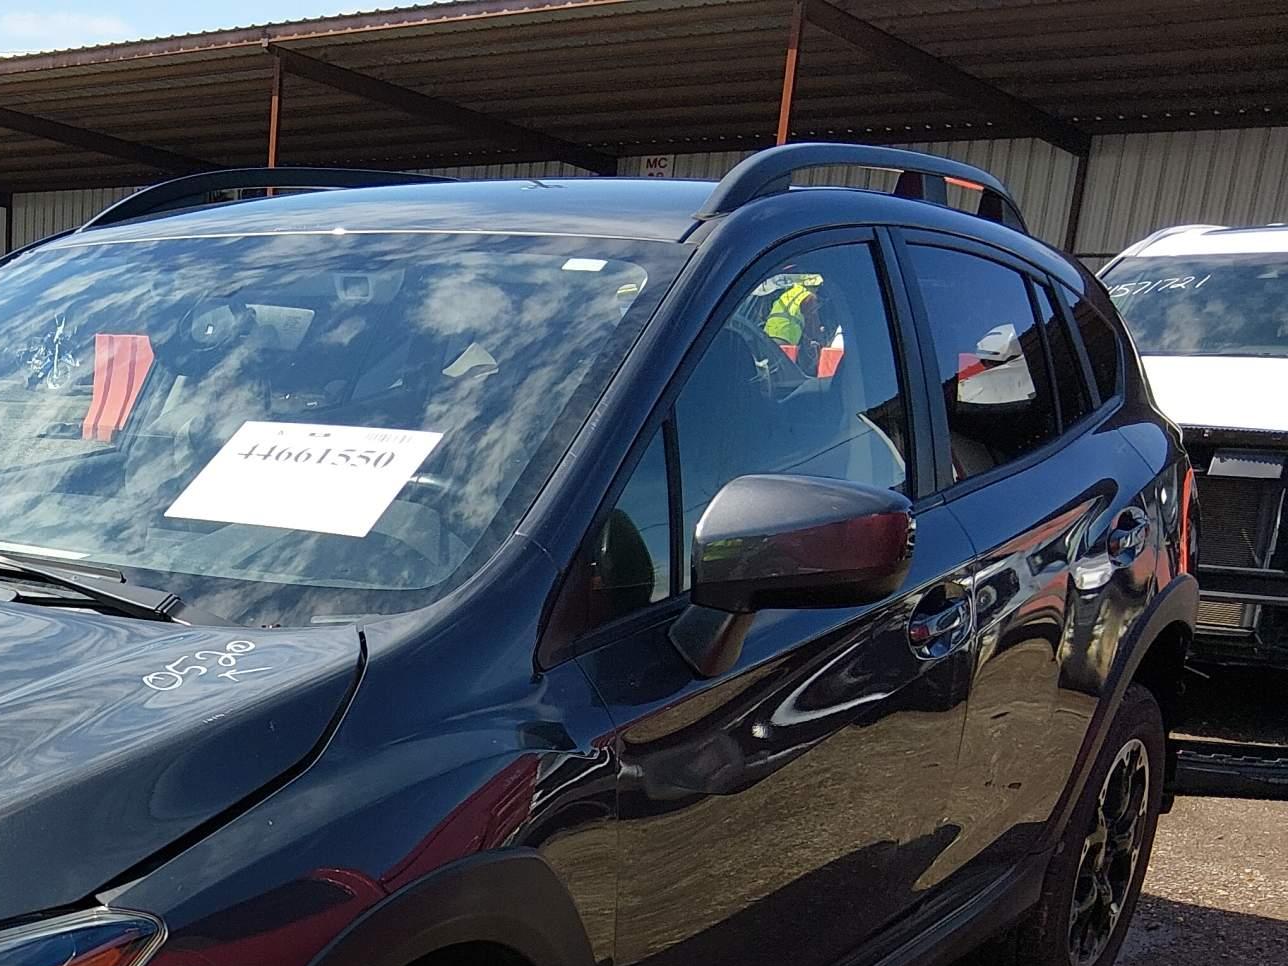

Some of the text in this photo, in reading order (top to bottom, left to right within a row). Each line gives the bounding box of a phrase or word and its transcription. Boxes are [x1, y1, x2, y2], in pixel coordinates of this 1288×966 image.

[646, 156, 668, 169] MC
[237, 443, 396, 469] 44661550
[142, 640, 256, 691] 0520
